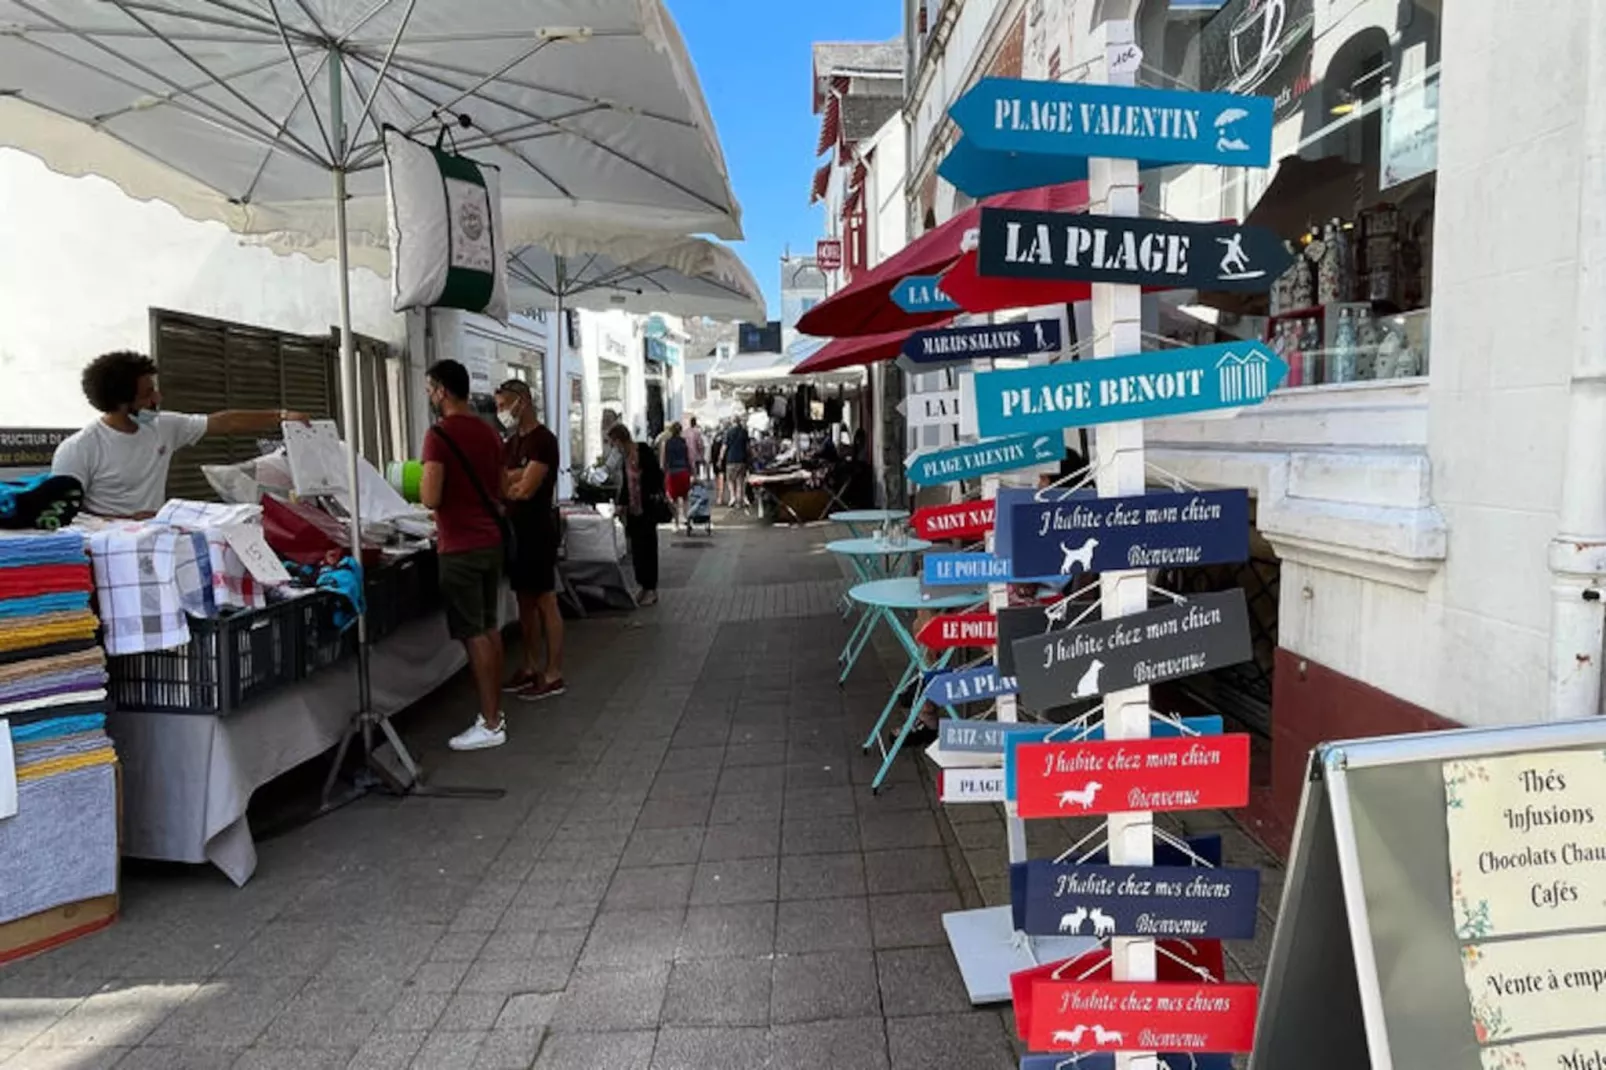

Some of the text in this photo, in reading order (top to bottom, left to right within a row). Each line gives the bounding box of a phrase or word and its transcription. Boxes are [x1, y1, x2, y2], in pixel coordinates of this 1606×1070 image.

[994, 98, 1200, 141] PLAGE VALENTIN
[1004, 222, 1191, 275] LA PLAGE
[908, 286, 930, 304] LA
[922, 330, 1021, 354] MARAIS SALANTS
[1001, 377, 1092, 417] PLAGE
[1100, 369, 1204, 408] BENOIT
[925, 399, 947, 418] LA
[922, 443, 1025, 479] PLAGE VALENTIN
[926, 511, 966, 532] SAINT
[1105, 502, 1142, 528] chez
[1145, 506, 1178, 524] mon
[1181, 496, 1222, 522] chien
[1128, 543, 1202, 567] Bienvenue
[936, 560, 953, 578] LE
[942, 620, 958, 639] LE
[1107, 624, 1143, 650] chez
[1146, 618, 1178, 640] mon
[1182, 606, 1222, 631] chien
[1133, 651, 1206, 684] Bienvenue
[945, 678, 970, 700] LA
[1107, 747, 1142, 770] chez
[1146, 752, 1178, 768] mon
[1181, 743, 1221, 766] chien
[960, 780, 1004, 793] PLAGE
[1518, 768, 1567, 793] Thés
[1127, 784, 1200, 809] Bienvenue
[1503, 804, 1594, 833] Infusions
[1478, 845, 1557, 874] Chocolats
[1054, 872, 1232, 898] J'habite chez mes chiens
[1531, 879, 1578, 909] Cafés
[1135, 912, 1208, 934] Bienvenue
[1487, 972, 1543, 997] Vente
[1547, 968, 1559, 990] à
[1120, 989, 1153, 1011] chez
[1156, 995, 1183, 1012] mes
[1186, 990, 1231, 1012] chiens
[1138, 1027, 1208, 1048] Bienvenue
